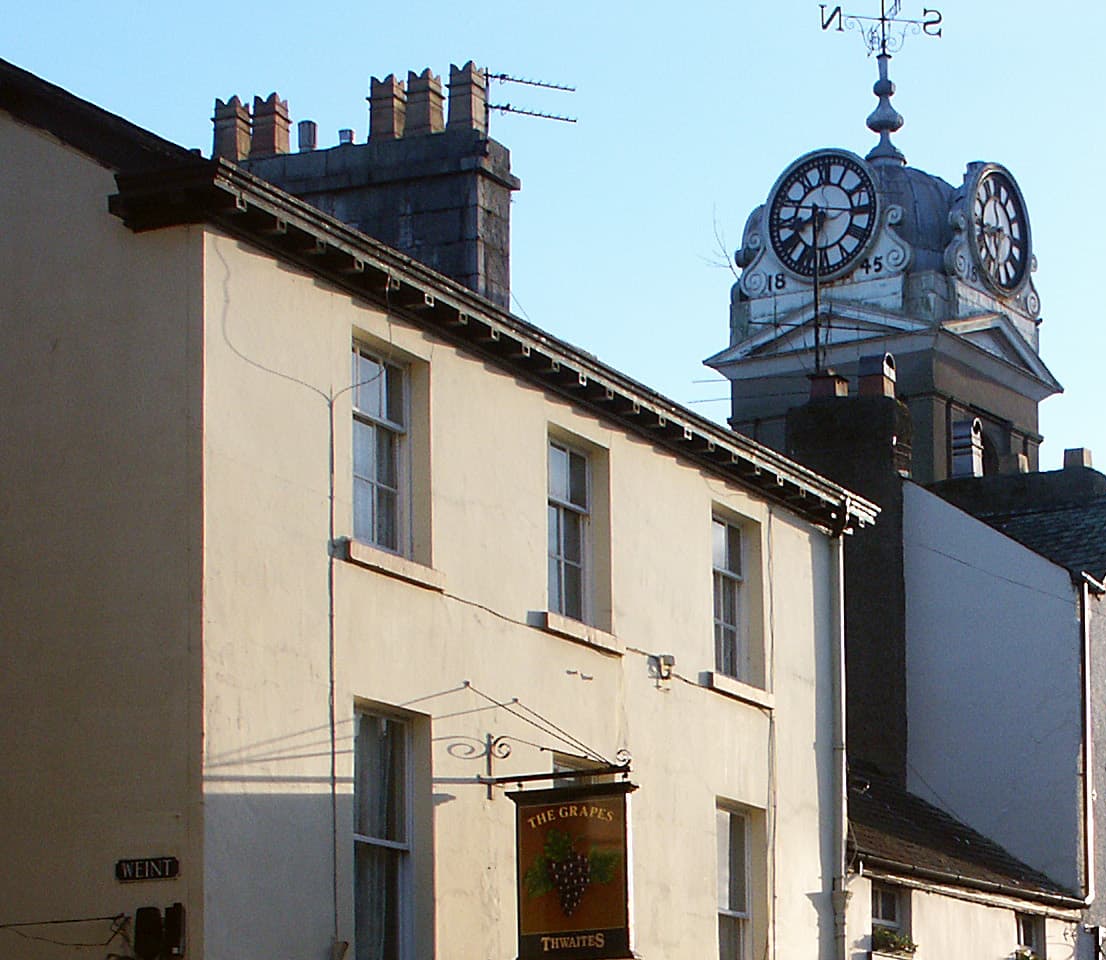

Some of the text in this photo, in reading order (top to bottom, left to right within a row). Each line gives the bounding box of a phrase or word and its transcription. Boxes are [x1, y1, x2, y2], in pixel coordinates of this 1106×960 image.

[860, 256, 883, 274] 45
[767, 273, 786, 291] 18
[527, 805, 616, 829] THE GRAPES
[120, 859, 172, 878] WEINT
[540, 932, 606, 951] THWAITES
